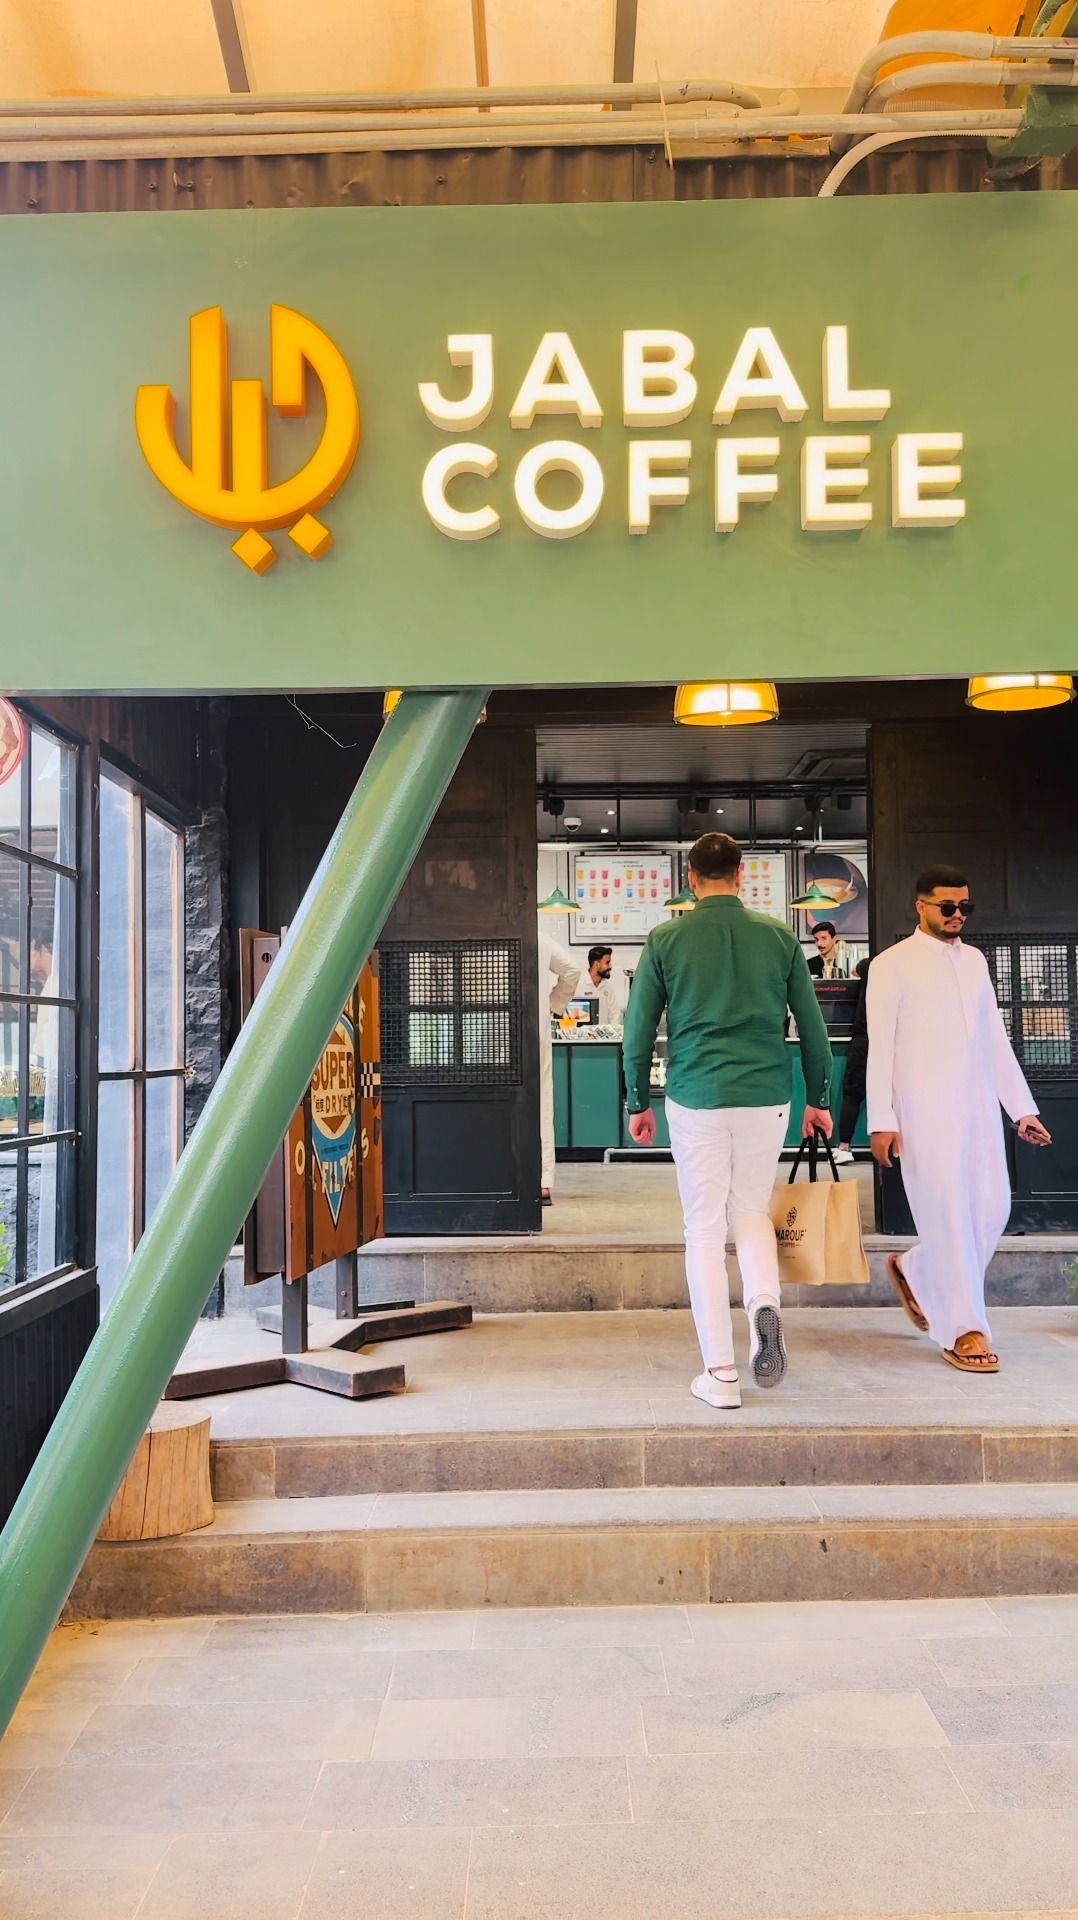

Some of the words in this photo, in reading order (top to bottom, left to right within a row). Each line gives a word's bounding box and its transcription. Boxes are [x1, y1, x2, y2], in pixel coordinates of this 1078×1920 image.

[418, 325, 891, 431] JABAL
[421, 432, 966, 540] COFFEE
[311, 1051, 355, 1091] SUPER
[295, 1140, 317, 1191] OL
[322, 1127, 370, 1194] FILTES
